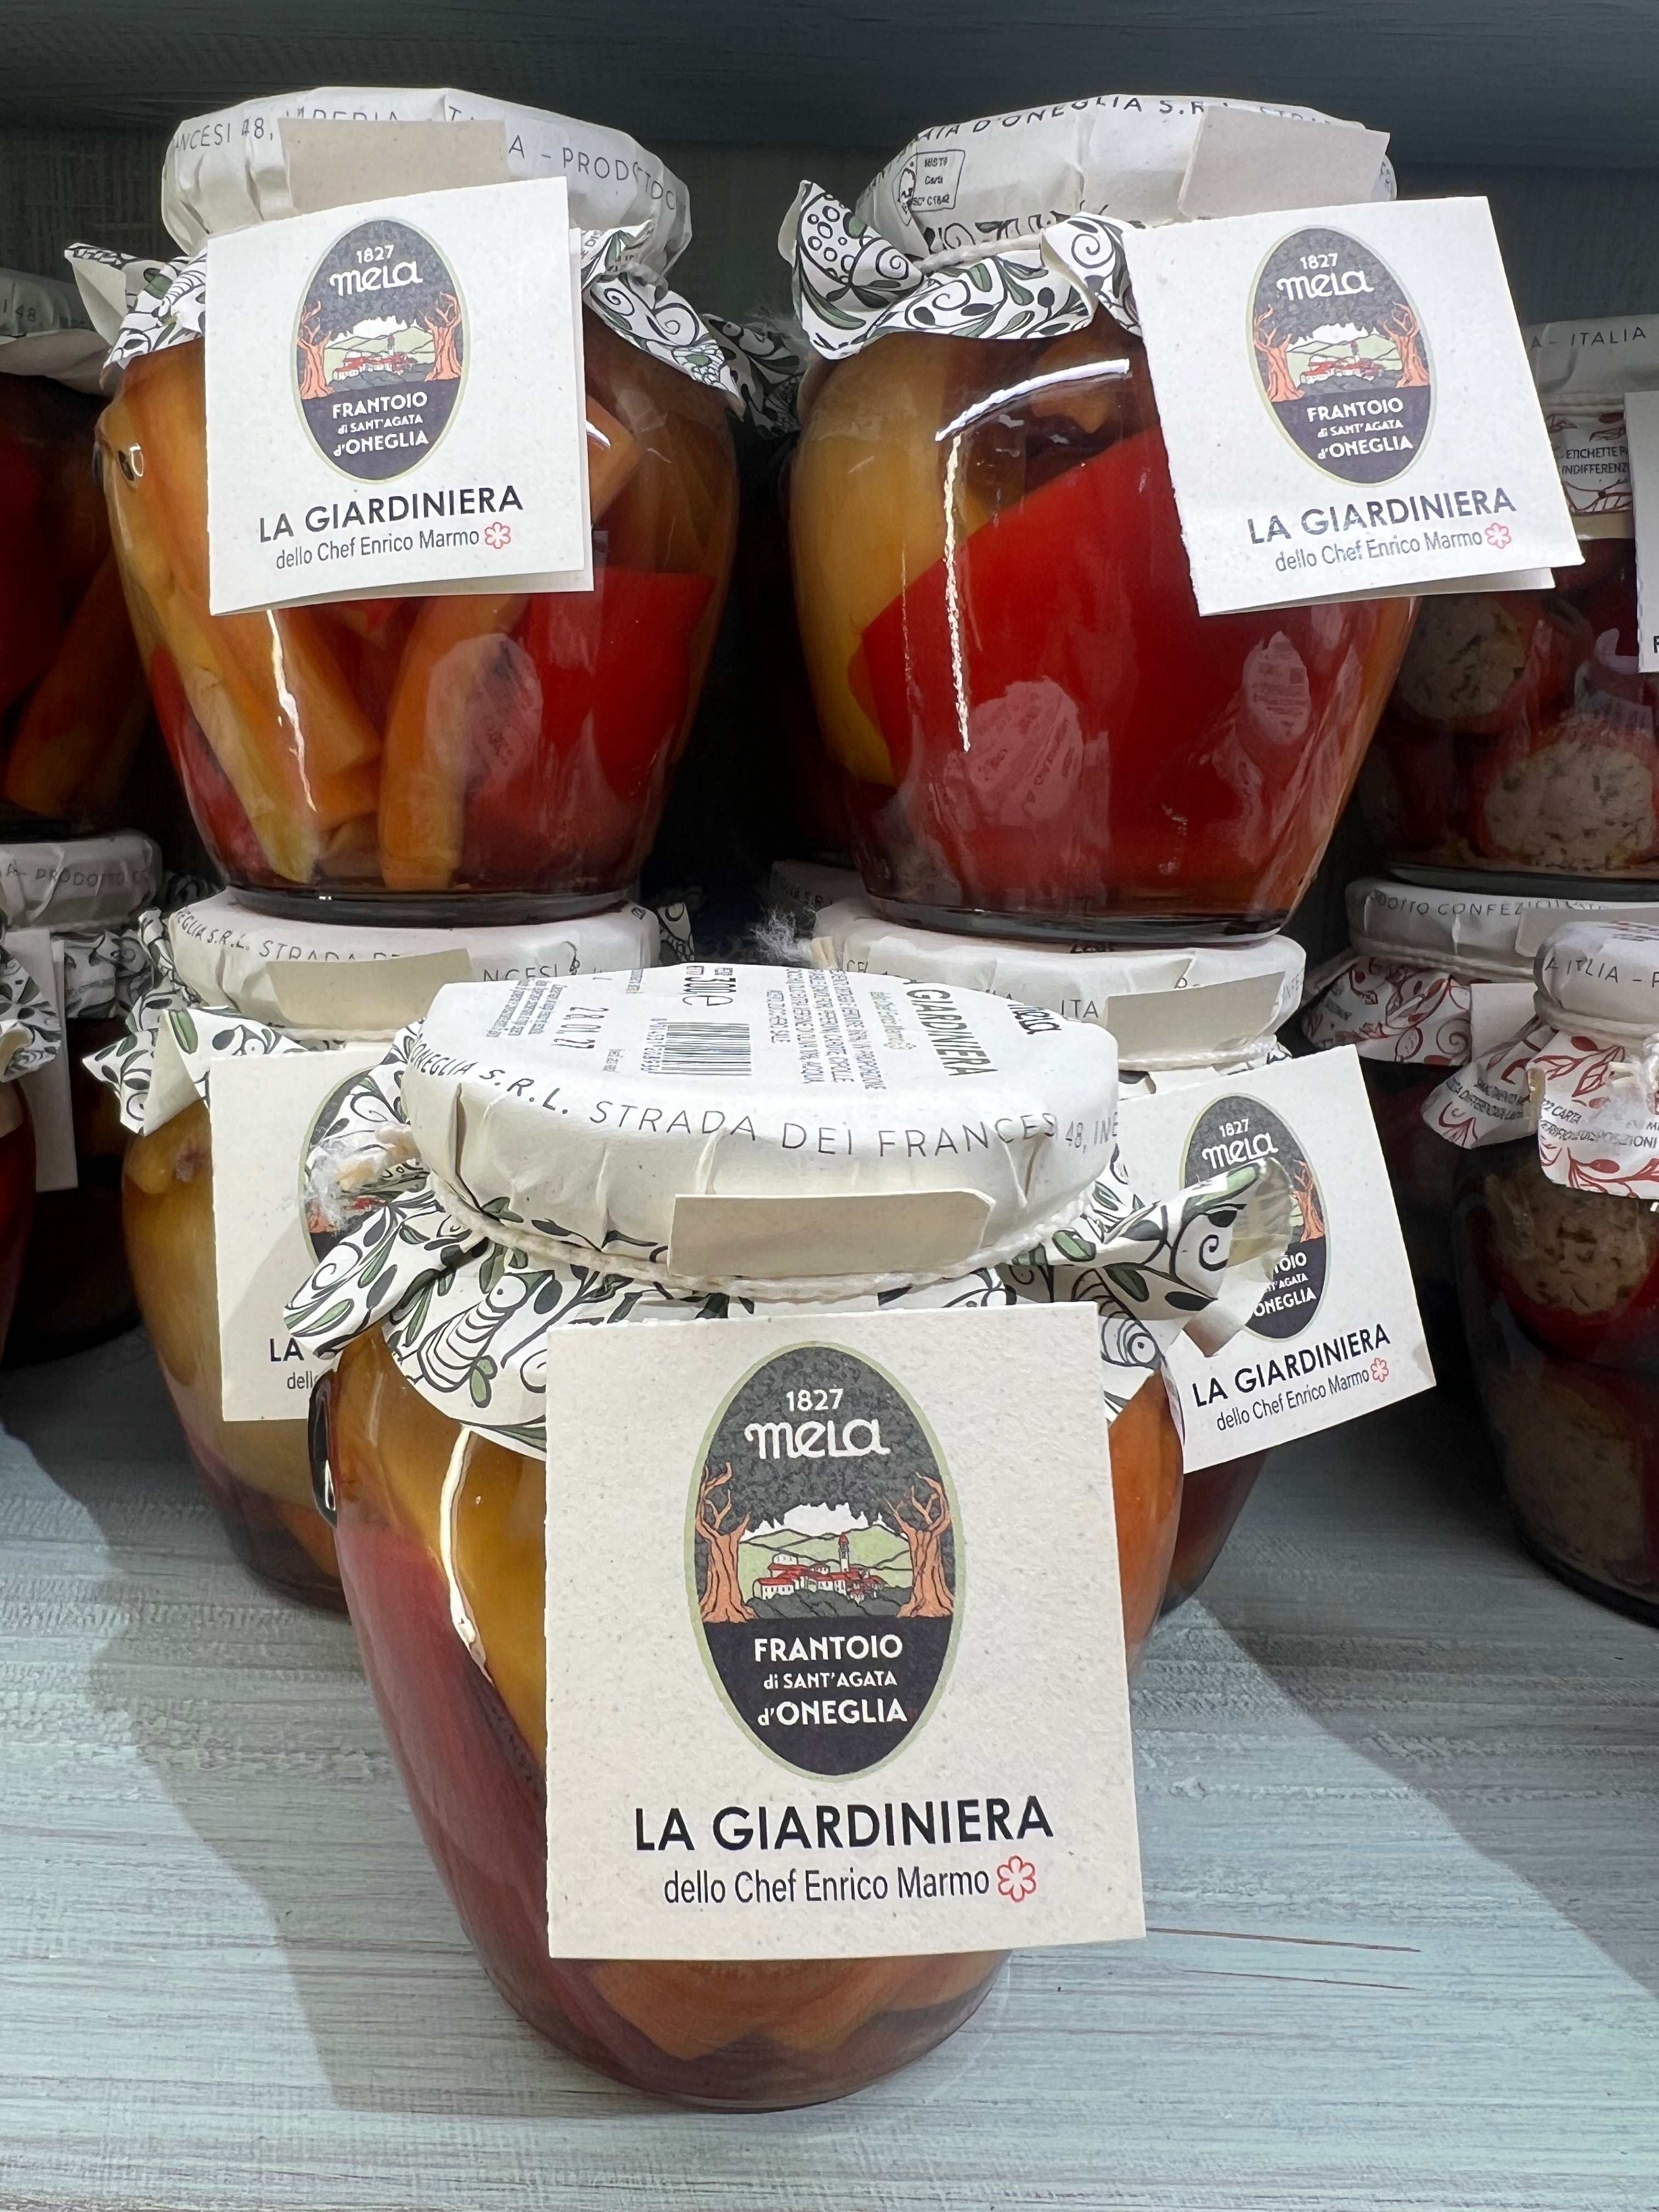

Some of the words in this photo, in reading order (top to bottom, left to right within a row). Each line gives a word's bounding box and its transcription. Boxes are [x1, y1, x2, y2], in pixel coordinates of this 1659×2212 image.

[356, 244, 394, 264] 1827
[1300, 252, 1338, 271] 1827
[1571, 326, 1646, 346] ITALIA
[332, 391, 428, 419] FRANTOIO
[1306, 397, 1404, 423] FRANTOIO
[337, 423, 348, 435] di
[349, 414, 424, 433] SANT'AGATA
[1317, 428, 1329, 438] di
[1330, 419, 1404, 437] SANT'AGATA
[333, 430, 429, 457] d'ONEGLIA
[1317, 435, 1414, 460] d'ONEGLIA
[258, 512, 295, 543] LA
[304, 485, 523, 532] GIARDINIERA
[1247, 515, 1291, 545] LA
[1301, 487, 1517, 535] GIARDINIERA
[276, 545, 312, 569] dello
[317, 537, 357, 562] Chef
[360, 532, 413, 557] Enrico
[419, 528, 479, 549] Marmo
[1275, 549, 1318, 573] dello
[1322, 540, 1363, 566] Chef
[1367, 535, 1420, 560] Enrico
[1424, 530, 1482, 550] Marmo
[906, 989, 998, 1076] GIARDINIERA
[479, 1069, 568, 1115] S.R.L.
[590, 1101, 756, 1142] STRADA
[782, 1122, 853, 1155] DEI
[1219, 1118, 1250, 1138] 1827
[269, 1337, 305, 1362] LA
[1192, 1375, 1228, 1408] LA
[1234, 1323, 1391, 1393] GIARDINIERA
[786, 1388, 843, 1411] 1827
[1217, 1401, 1250, 1432] dello
[1252, 1391, 1285, 1420] Chef
[1287, 1378, 1327, 1410] Enrico
[1329, 1368, 1369, 1395] Marmo
[754, 1634, 903, 1662] FRANTOIO
[763, 1673, 780, 1690] di
[783, 1670, 897, 1689] SANT'AGATA
[757, 1697, 907, 1726] d'ONEGLIA
[635, 1807, 695, 1852] LA
[712, 1795, 1054, 1850] GIARDINIERA
[663, 1870, 726, 1904] dello
[734, 1868, 797, 1903] Chef
[806, 1867, 889, 1902] Enrico
[897, 1866, 990, 1899] Marmo
